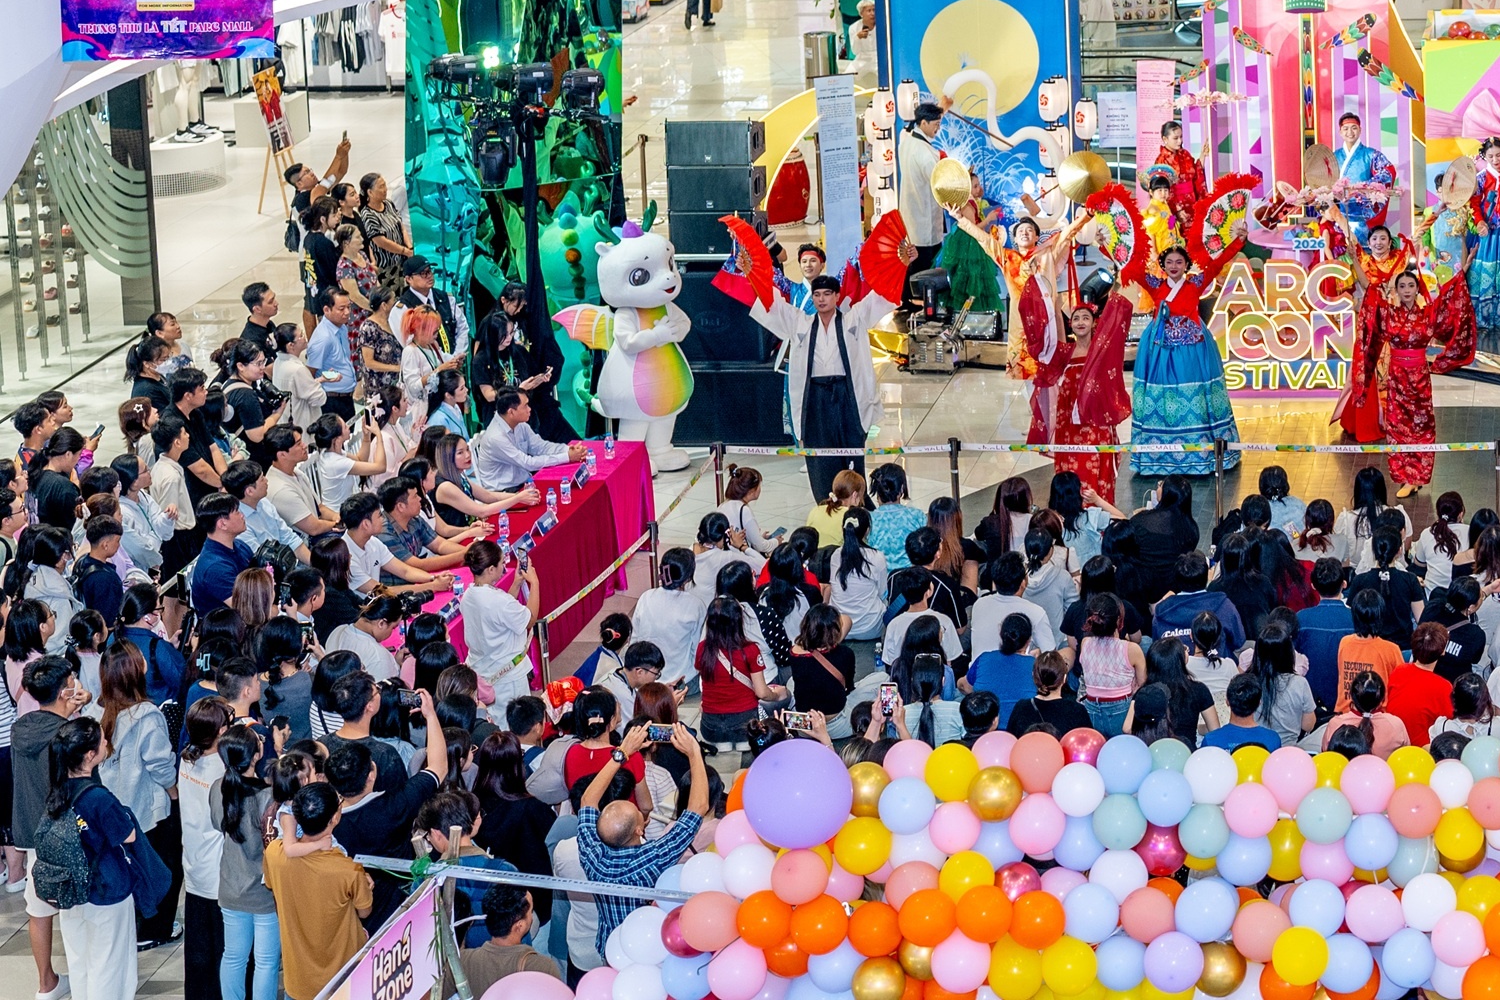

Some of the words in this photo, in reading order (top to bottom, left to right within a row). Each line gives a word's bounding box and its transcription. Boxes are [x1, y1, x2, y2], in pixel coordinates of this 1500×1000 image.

[78, 23, 116, 34] TRUNG
[118, 23, 142, 34] THU
[143, 20, 159, 34] LÀ
[160, 16, 188, 33] TẾT
[189, 23, 220, 33] PARC
[222, 22, 254, 32] MALL
[1292, 238, 1325, 250] 2026
[1343, 661, 1374, 672] SECURITY
